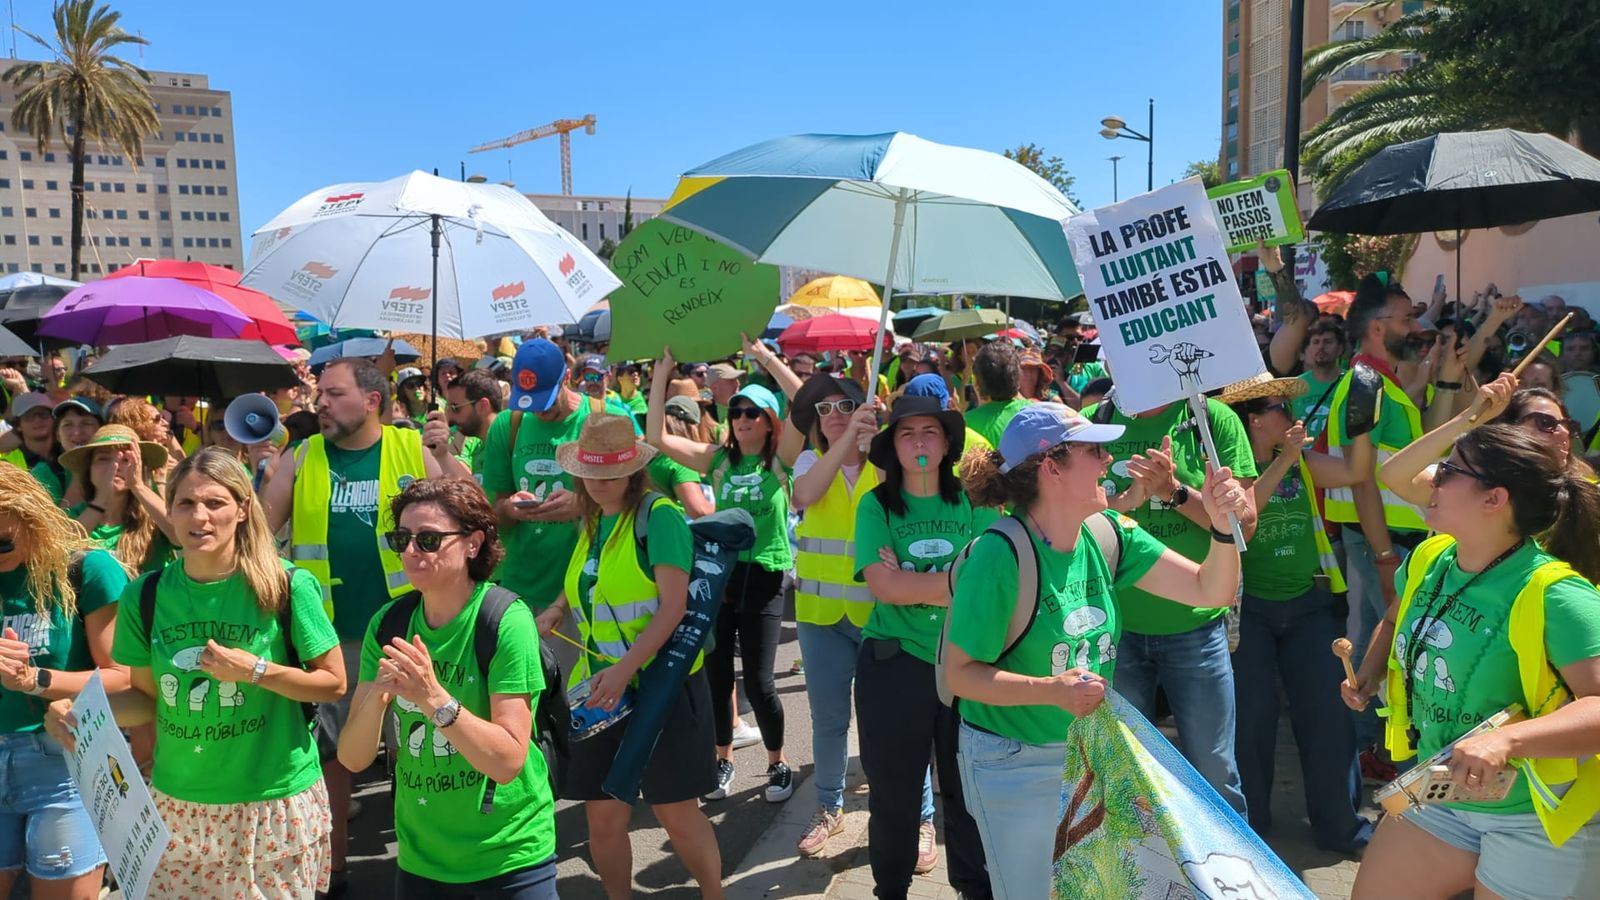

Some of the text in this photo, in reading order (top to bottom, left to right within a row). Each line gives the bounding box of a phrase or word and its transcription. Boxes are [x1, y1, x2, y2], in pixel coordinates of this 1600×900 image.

[320, 198, 365, 210] STEPV
[1216, 190, 1265, 216] NO FEM
[1089, 205, 1191, 258] LA PROFE
[1223, 206, 1272, 231] PASSOS
[1229, 223, 1276, 247] ENRERE
[613, 226, 694, 278] SOM VEU
[1100, 235, 1197, 288] LLUITANT
[632, 253, 741, 298] EDUCA I NO
[679, 276, 697, 289] ES
[1094, 275, 1169, 321] TAMBÉ
[1169, 256, 1227, 298] ESTÀ
[1118, 293, 1218, 347] EDUCANT
[583, 453, 604, 464] AMSTEL
[895, 520, 966, 540] ESTIMEM
[160, 620, 261, 646] ESTIMEM
[140, 804, 151, 824] NO
[140, 820, 159, 857] SENSE
